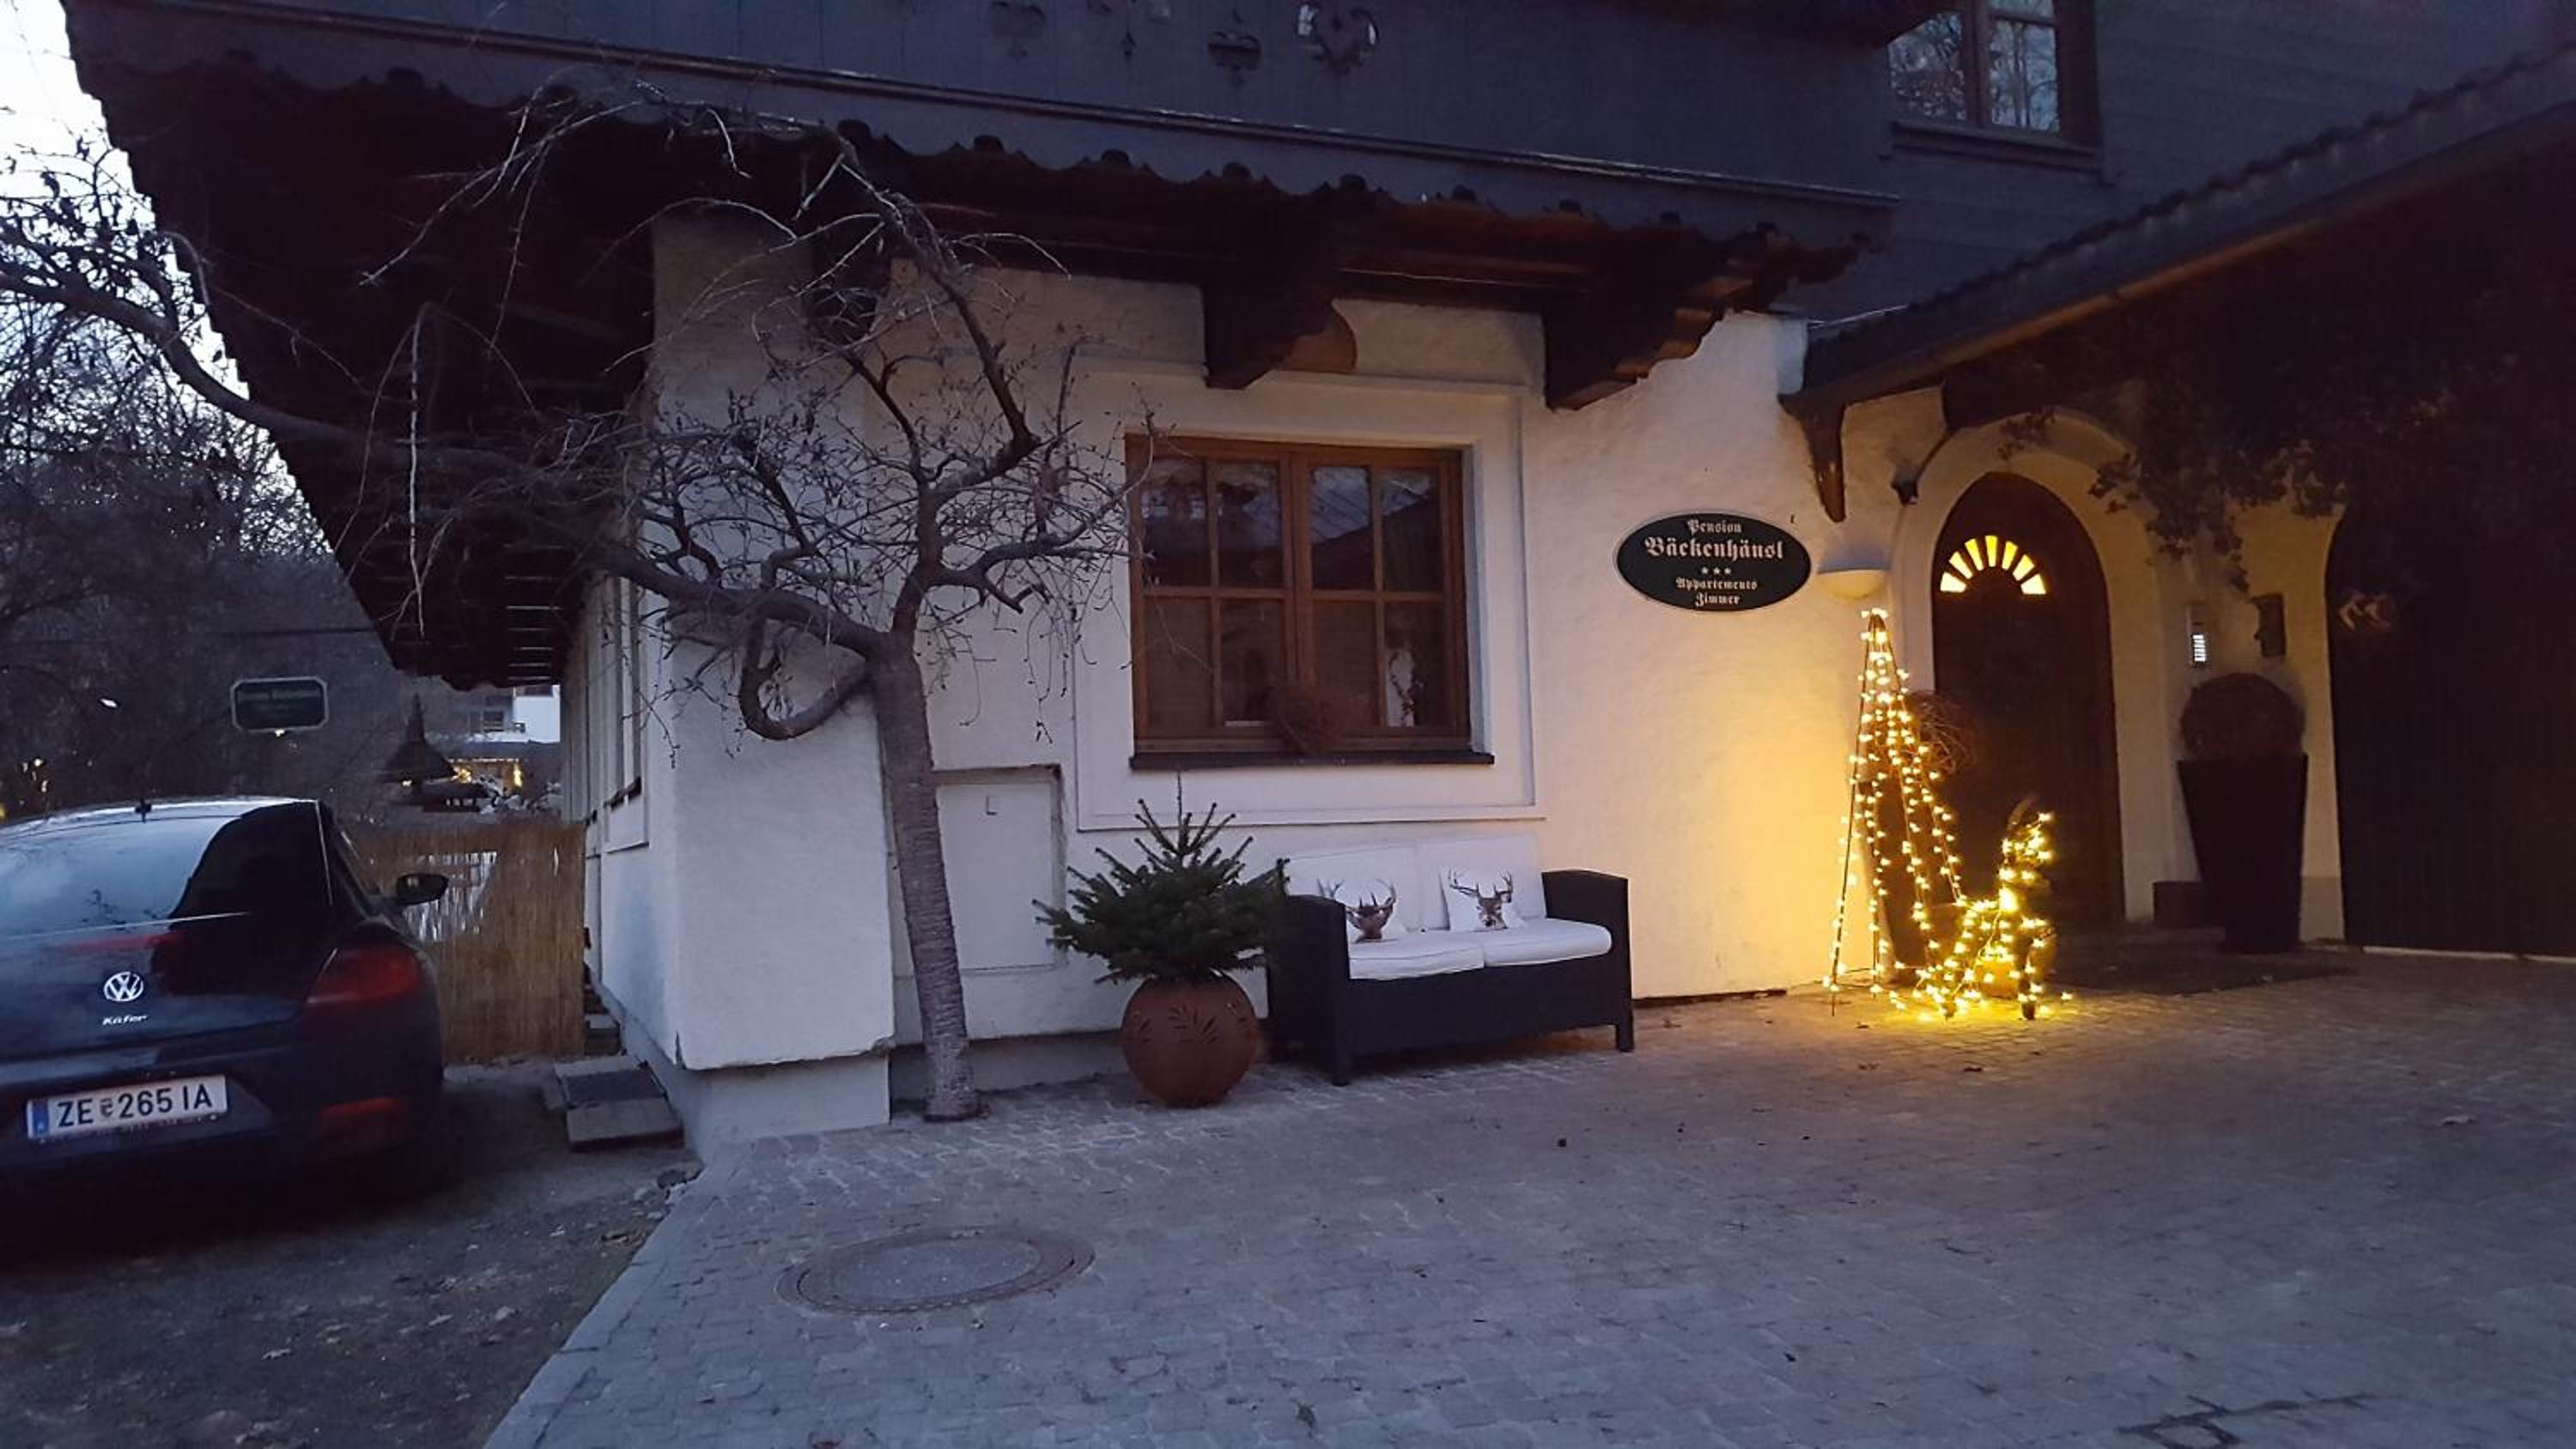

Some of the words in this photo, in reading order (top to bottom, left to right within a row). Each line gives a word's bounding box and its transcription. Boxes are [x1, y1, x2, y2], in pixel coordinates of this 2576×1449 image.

[1686, 518, 1742, 535] Pension
[1643, 536, 1784, 561] Bäckenhäusl
[1675, 576, 1758, 591] Appartements
[1694, 591, 1741, 607] Zimmer
[57, 1099, 94, 1128] ZE
[118, 1088, 173, 1119] 265
[182, 1083, 213, 1111] IA
